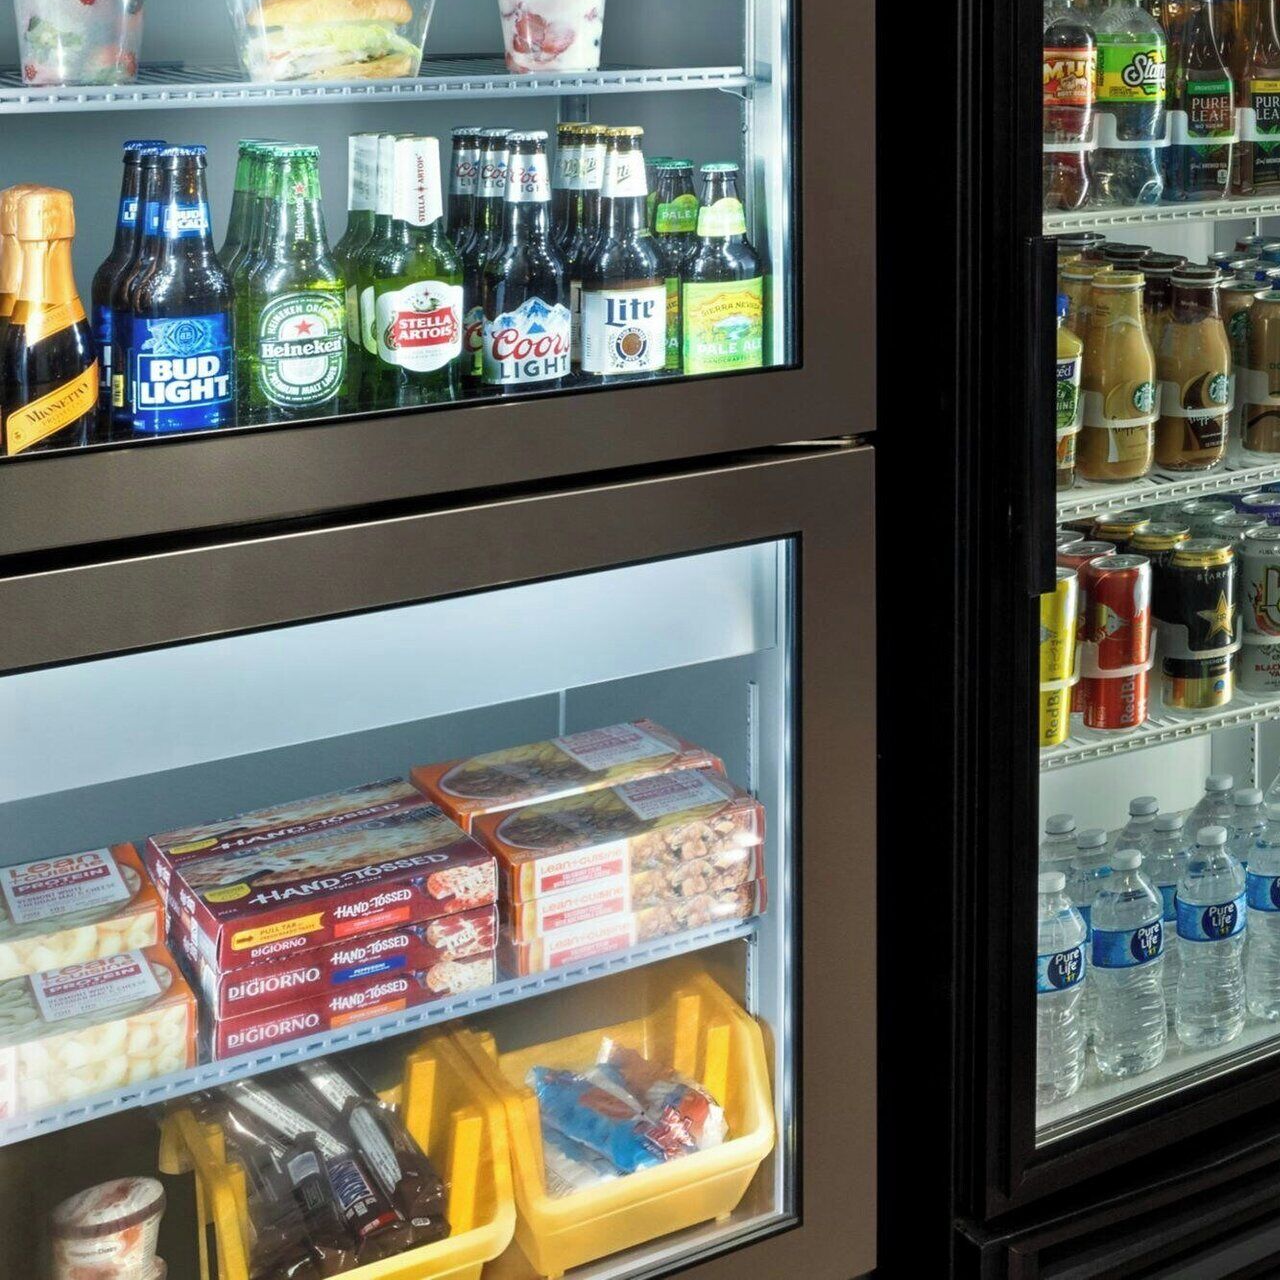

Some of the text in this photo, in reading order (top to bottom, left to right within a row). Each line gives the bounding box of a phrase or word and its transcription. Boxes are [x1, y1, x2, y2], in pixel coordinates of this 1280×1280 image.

[398, 316, 453, 330] STELLA
[604, 298, 654, 327] Lite
[398, 326, 454, 343] ARTOIS
[261, 337, 342, 359] Heineken
[152, 356, 221, 382] BUD
[500, 355, 567, 380] LIGHT
[140, 374, 230, 403] LIGHT
[330, 935, 409, 966] HAND-TOSSED
[1054, 949, 1079, 966] Pure
[1058, 959, 1078, 979] Life
[329, 980, 408, 1011] HAND-TOSSED
